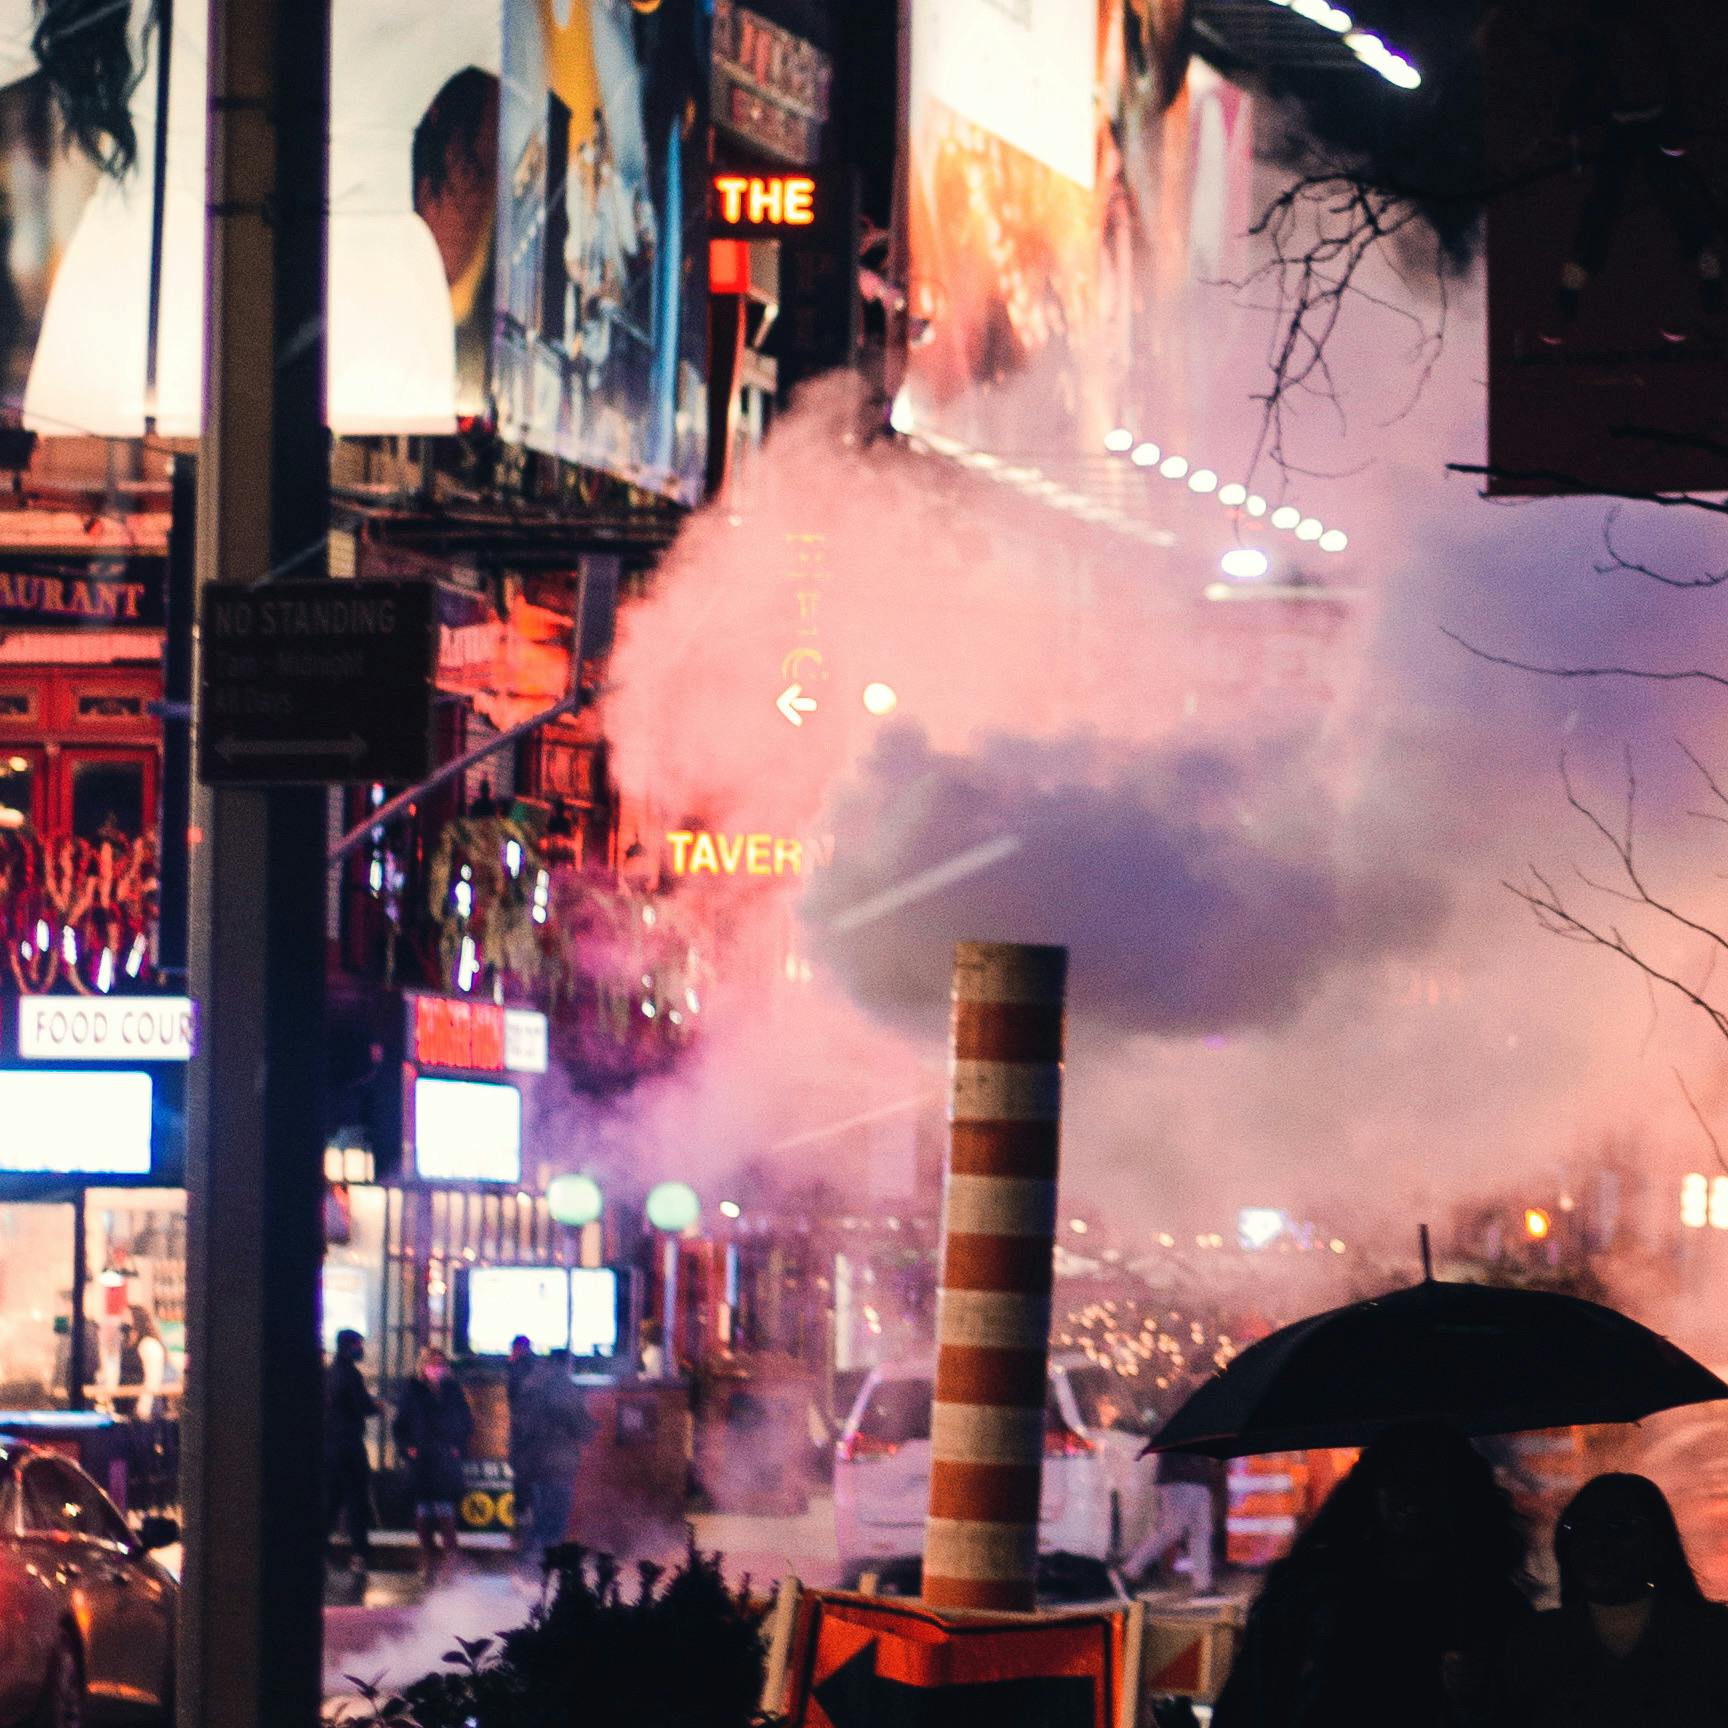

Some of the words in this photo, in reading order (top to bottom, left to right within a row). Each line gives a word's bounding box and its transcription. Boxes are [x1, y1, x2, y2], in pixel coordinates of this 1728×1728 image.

[714, 175, 816, 226] THE
[214, 600, 253, 636] NO
[260, 598, 396, 635] STANDING
[36, 1010, 108, 1045] FOOD
